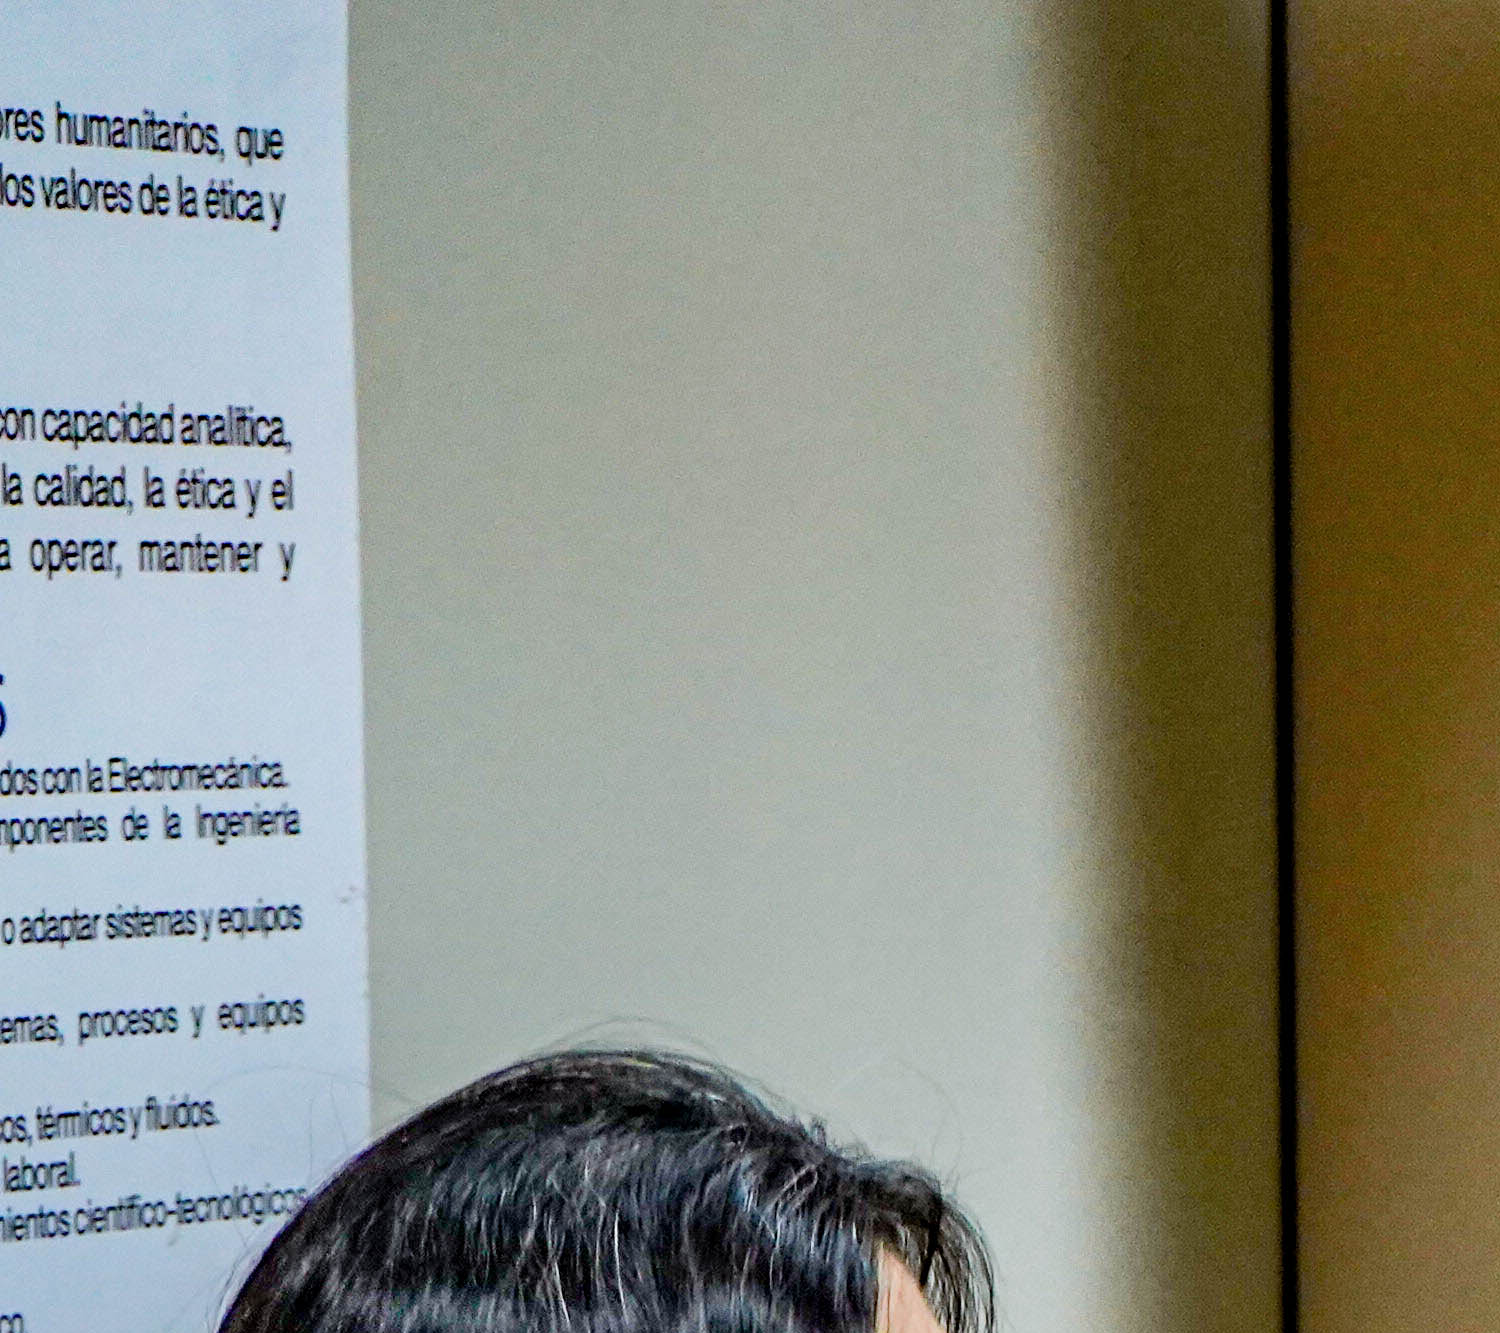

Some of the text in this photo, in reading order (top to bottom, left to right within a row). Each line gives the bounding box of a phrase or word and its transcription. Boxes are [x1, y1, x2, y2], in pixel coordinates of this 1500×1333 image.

[55, 101, 226, 162] humanitarios,
[235, 126, 284, 167] que
[41, 166, 132, 213] valores
[138, 173, 169, 215] de
[176, 174, 198, 217] la
[205, 177, 264, 221] ética
[270, 191, 286, 231] y
[42, 400, 174, 450] capacidad
[180, 405, 292, 453] analítica,
[2, 463, 294, 518] la calidad, la ética y el
[30, 539, 122, 580] operar,
[139, 533, 262, 572] mantener
[278, 542, 296, 581] y
[43, 767, 81, 794] con
[86, 758, 103, 792] la
[108, 755, 290, 792] Electromecánica.
[122, 805, 149, 840] de
[163, 804, 182, 840] la
[196, 803, 301, 846] Ingeniería
[2, 898, 303, 948] o adaptar sistemas y equipos
[78, 1006, 179, 1046] procesos
[191, 1005, 206, 1039] y
[217, 993, 304, 1034] equipos
[36, 1101, 126, 1140] térmicos
[129, 1106, 142, 1139] y
[3, 1150, 80, 1191] laboral.
